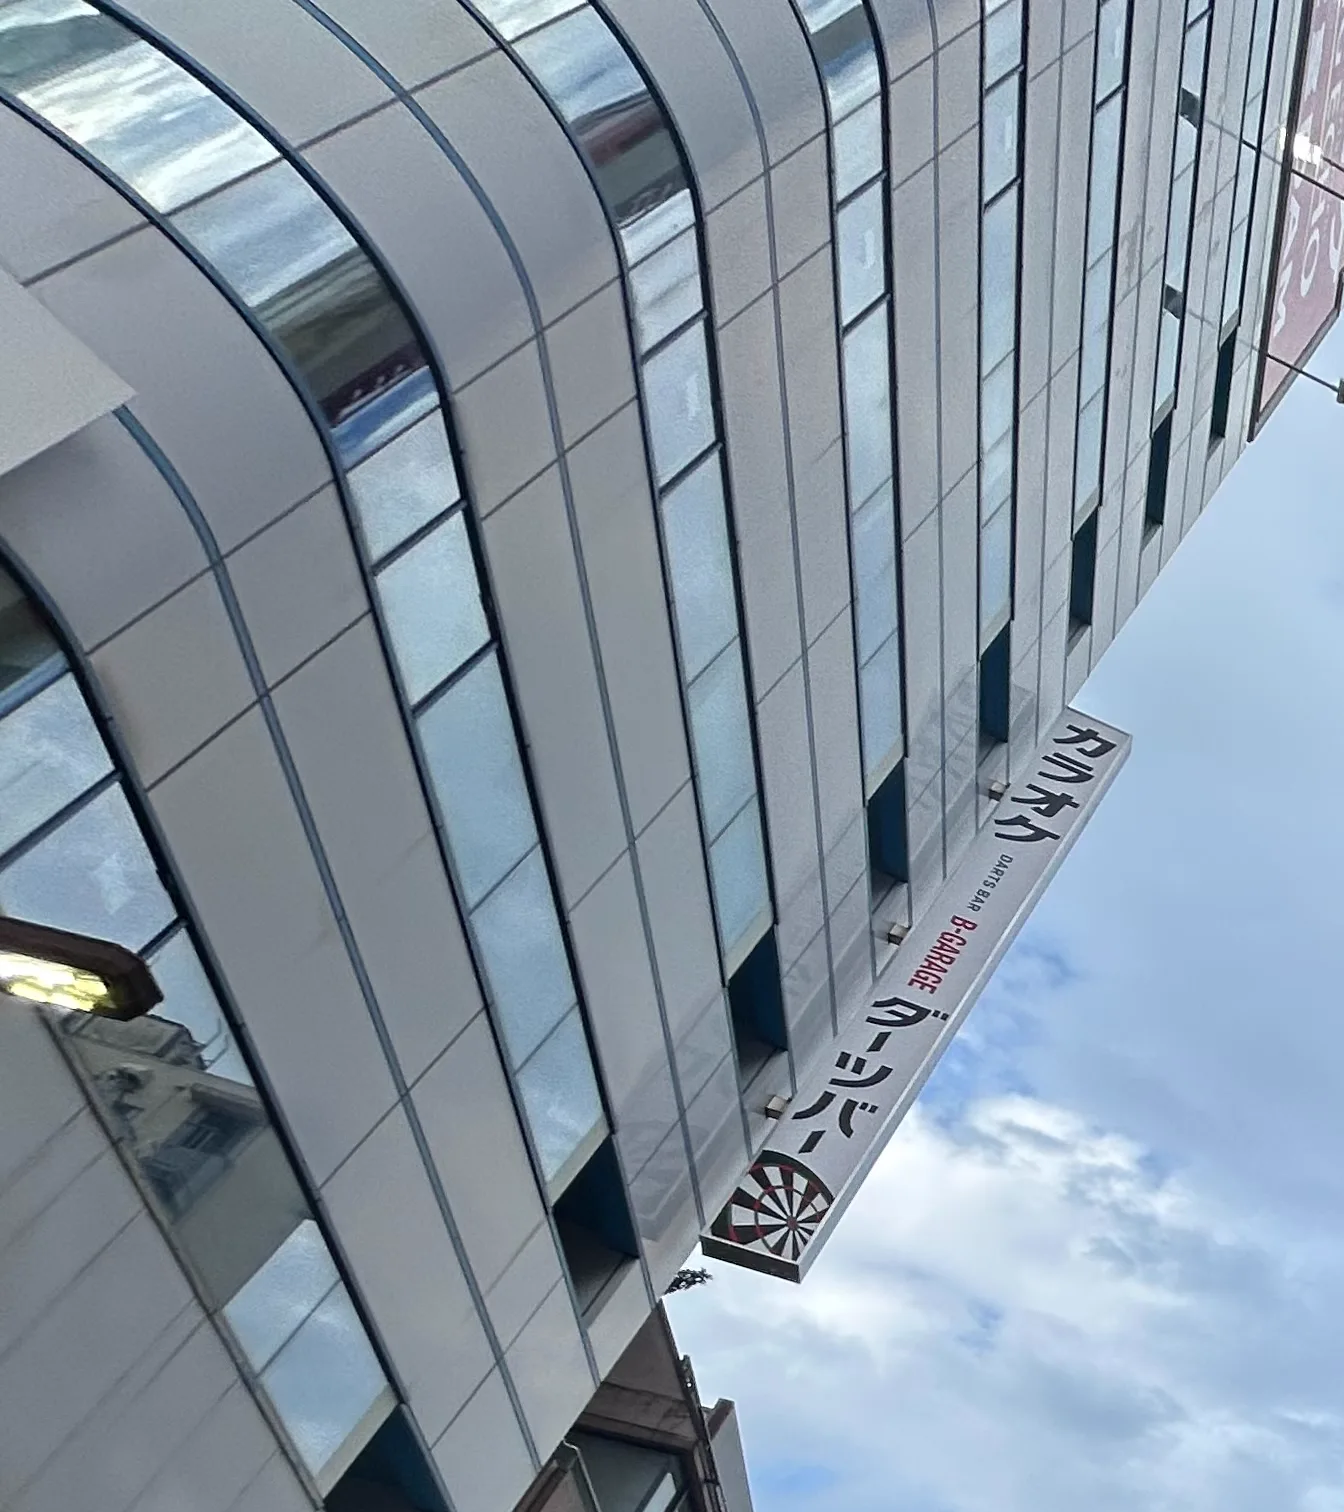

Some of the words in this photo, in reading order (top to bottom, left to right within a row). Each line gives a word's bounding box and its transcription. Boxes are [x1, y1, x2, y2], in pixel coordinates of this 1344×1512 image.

[995, 724, 1117, 842] カラオケ
[982, 854, 1014, 890] DARTS
[908, 915, 977, 995] B-GARAGE
[792, 996, 949, 1154] ダーツバー
